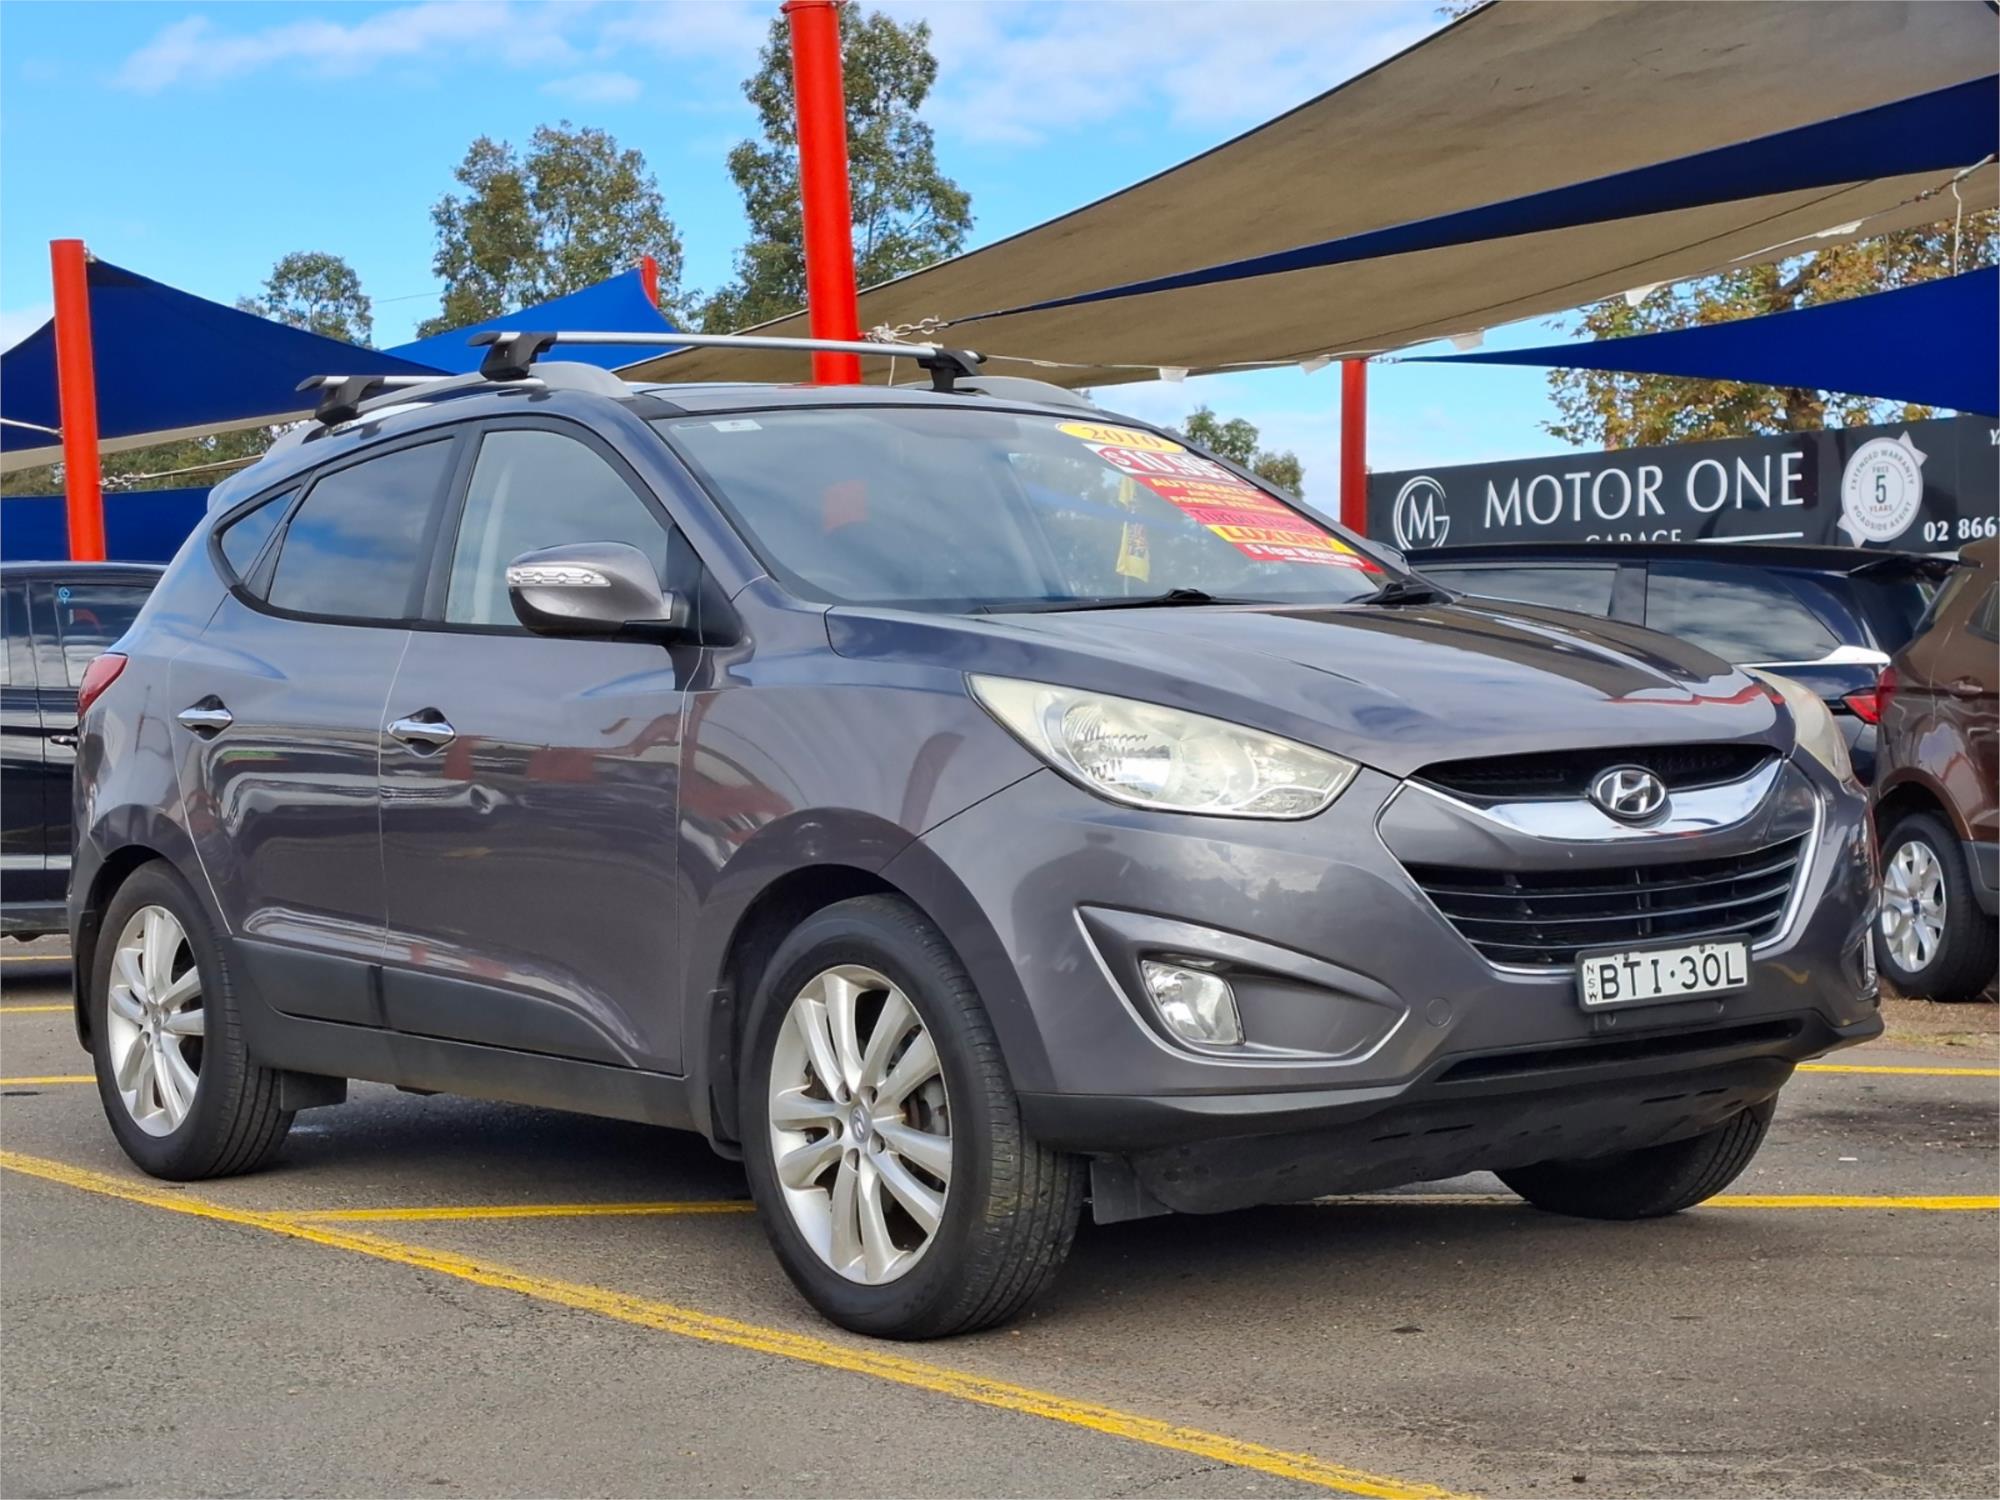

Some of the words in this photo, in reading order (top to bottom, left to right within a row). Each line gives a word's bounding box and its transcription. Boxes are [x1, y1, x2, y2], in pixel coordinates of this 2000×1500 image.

[1081, 427, 1162, 448] 2010
[1850, 450, 1879, 490] EXTENDED
[1880, 449, 1914, 485] WARRANTY
[1483, 466, 1666, 528] MOTOR
[1686, 451, 1804, 513] ONE
[1875, 474, 1887, 504] 5
[1853, 504, 1888, 531] ROADSIDE
[1889, 501, 1912, 528] ASSIST
[1869, 504, 1893, 512] YEARS
[1219, 526, 1334, 548] LUXURY
[1923, 520, 1949, 542] 02
[1958, 516, 2000, 539] 866
